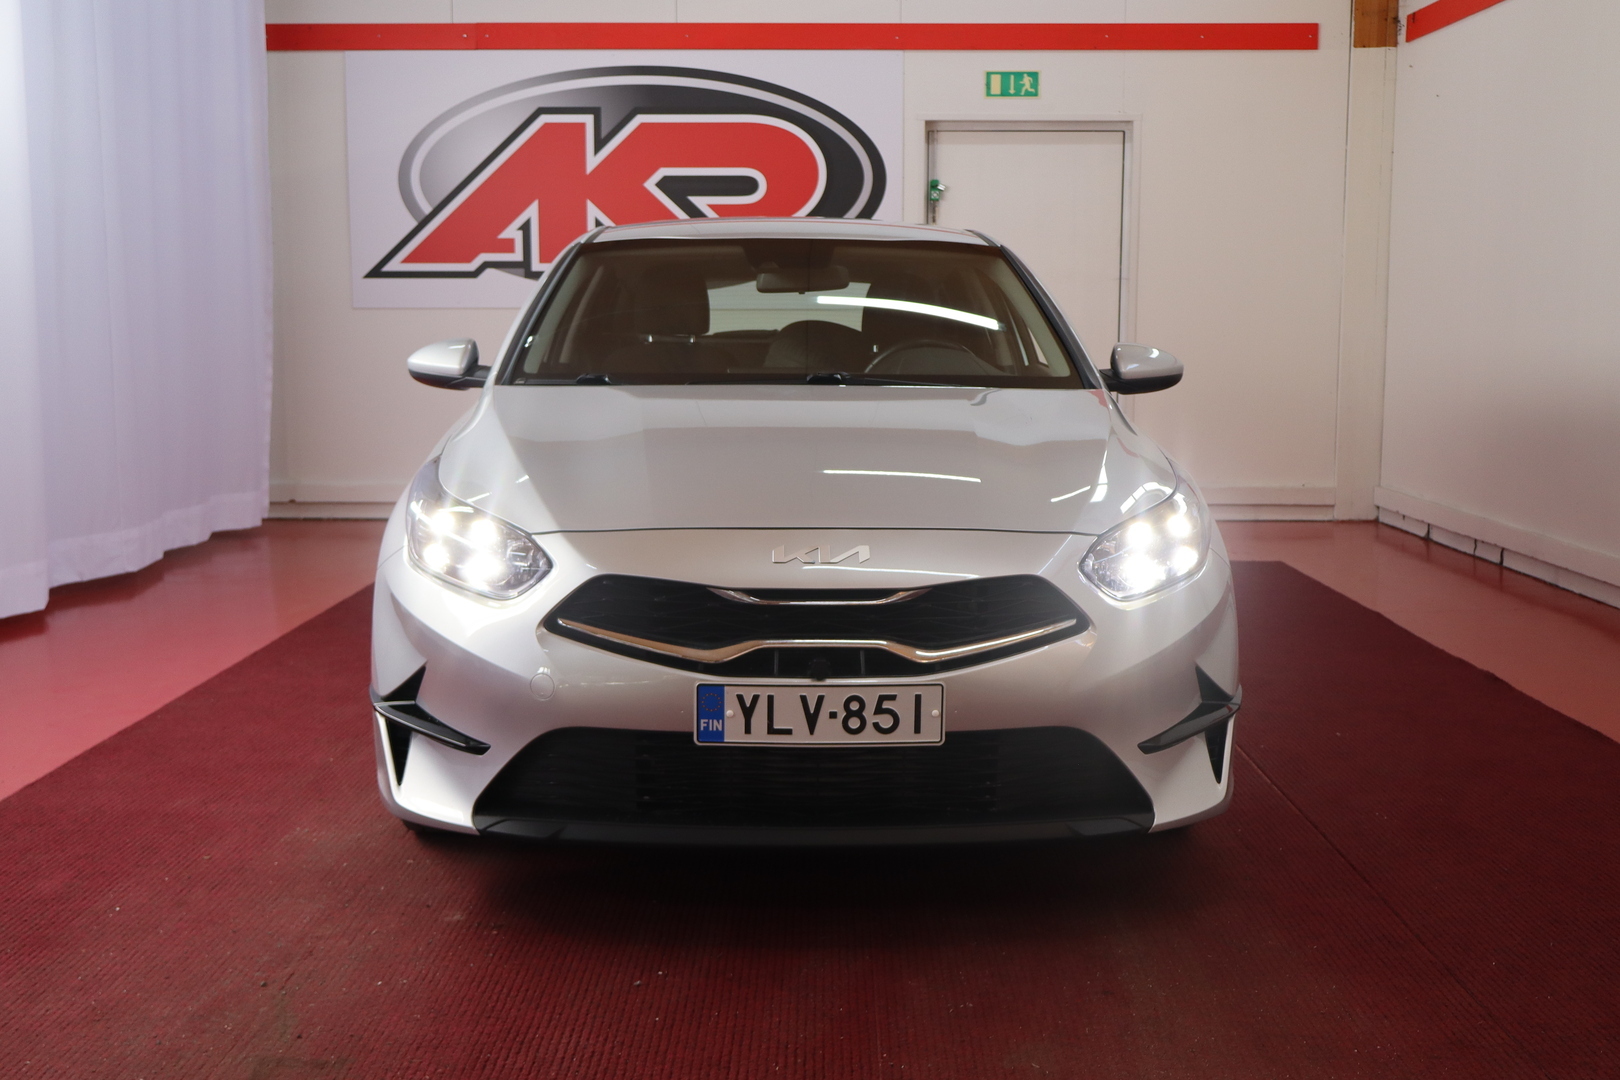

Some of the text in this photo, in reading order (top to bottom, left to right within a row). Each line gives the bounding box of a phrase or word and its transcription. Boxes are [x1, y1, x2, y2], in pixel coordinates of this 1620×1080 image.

[772, 544, 870, 564] KIA
[736, 693, 922, 735] YLV-851
[700, 719, 723, 731] FIN
